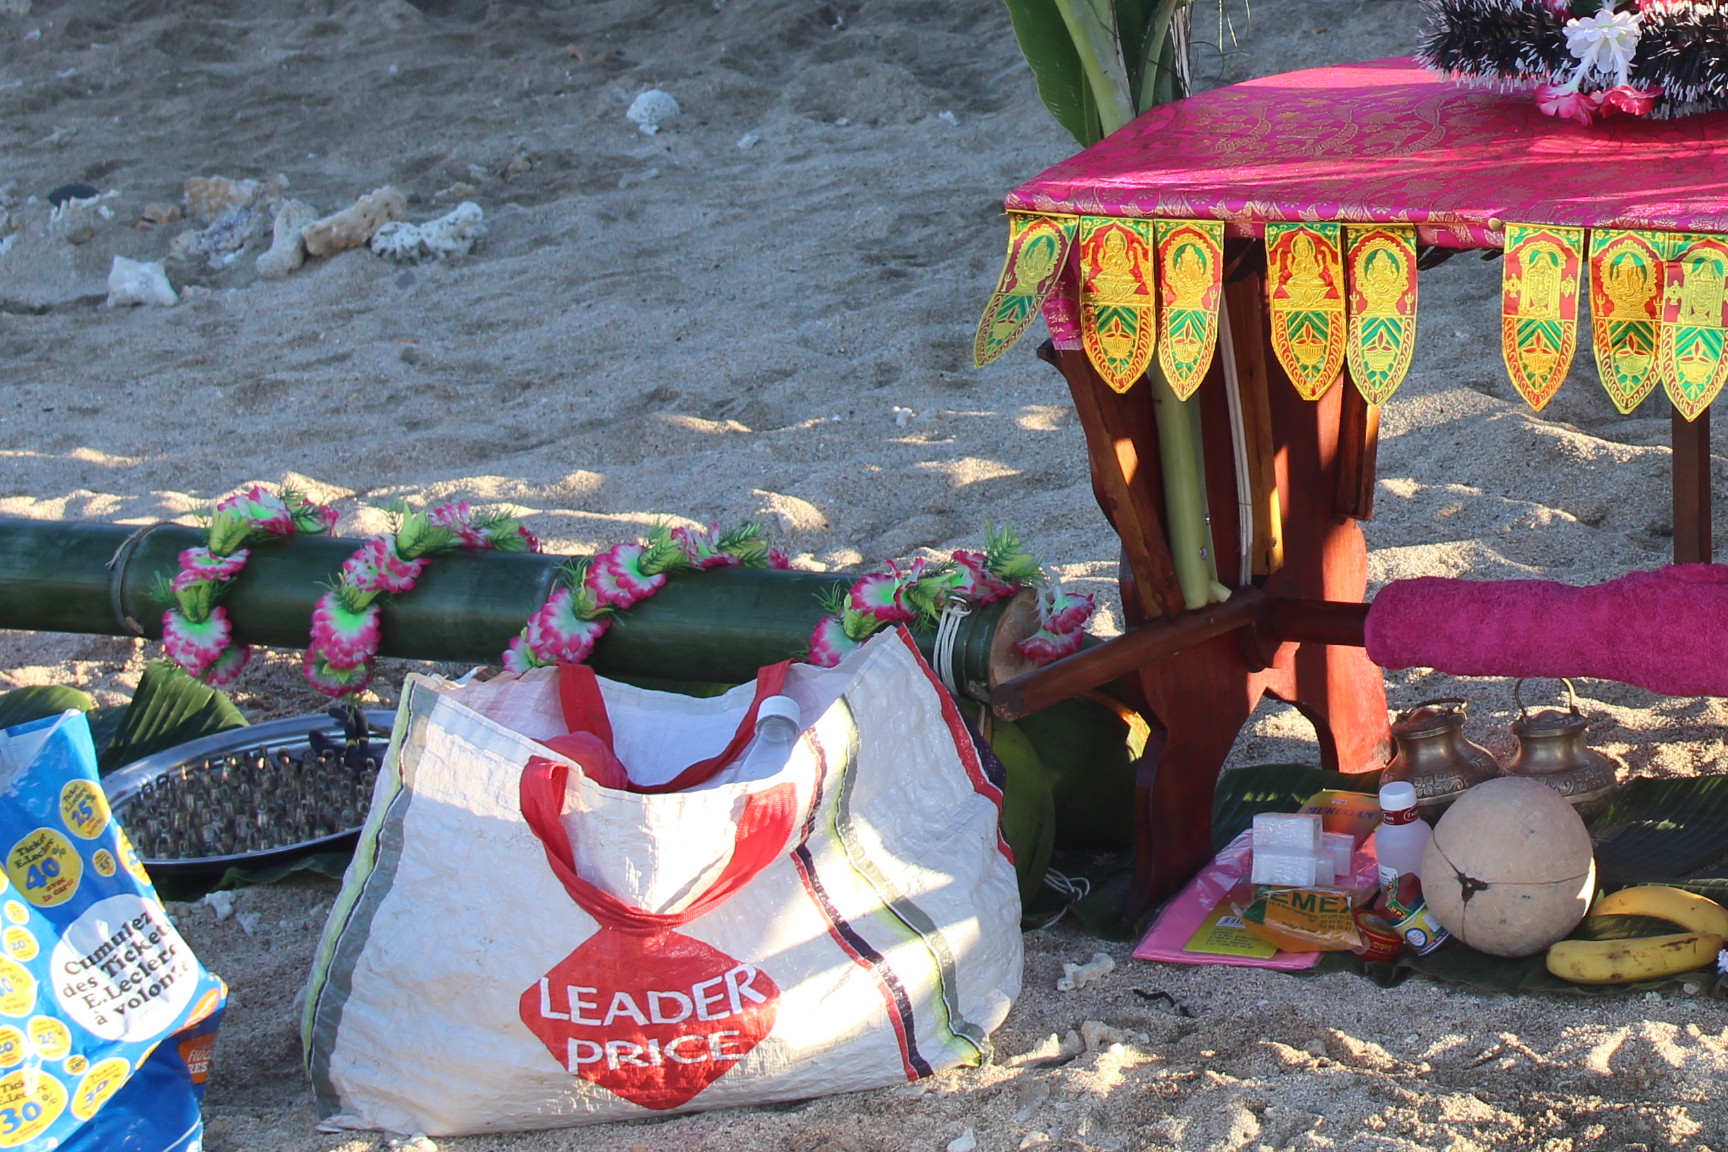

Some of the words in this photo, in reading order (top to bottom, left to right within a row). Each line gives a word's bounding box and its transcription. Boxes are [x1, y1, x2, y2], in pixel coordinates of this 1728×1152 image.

[64, 910, 152, 975] Cumulez
[62, 976, 99, 998] des
[539, 963, 767, 1027] LEADER
[95, 1010, 108, 1026] à
[567, 1030, 747, 1075] PRICE
